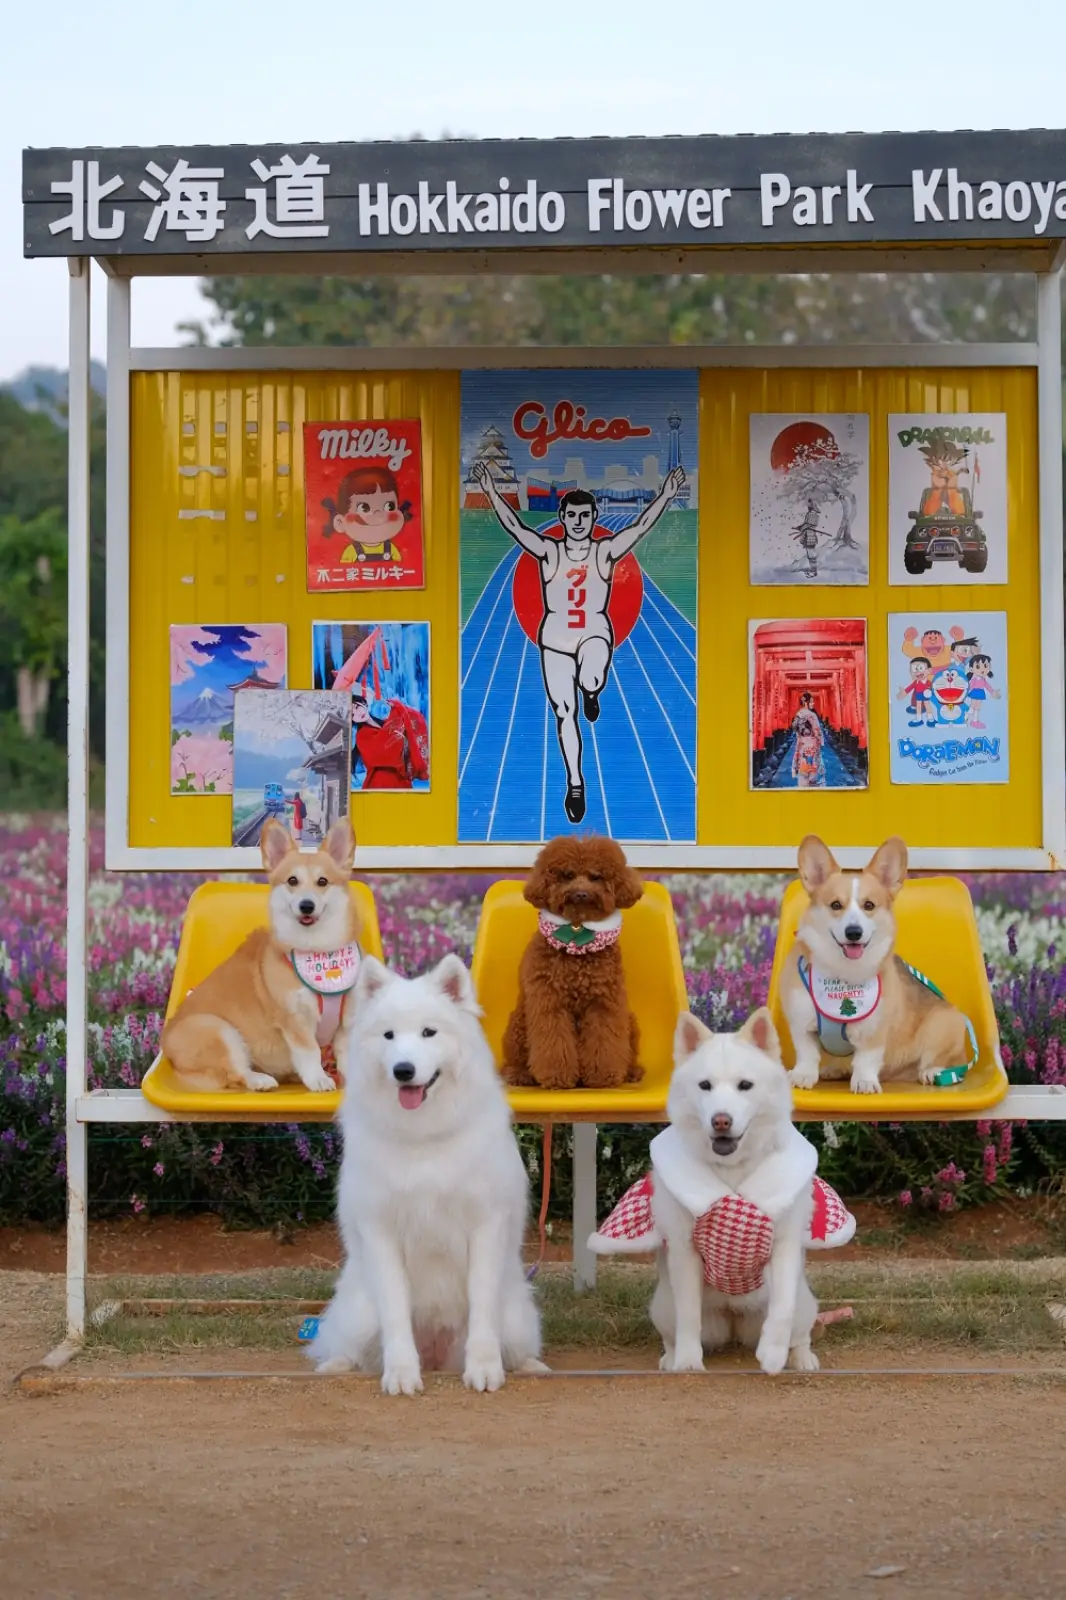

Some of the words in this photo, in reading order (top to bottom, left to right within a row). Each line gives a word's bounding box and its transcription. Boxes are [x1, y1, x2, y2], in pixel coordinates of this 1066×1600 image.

[48, 153, 331, 242] 北海道
[358, 176, 566, 237] Hokkaido
[587, 176, 732, 233] Flower
[760, 169, 876, 227] Park
[317, 428, 413, 472] Milky
[512, 399, 652, 459] Glico
[316, 564, 416, 583] 不二家ミルキー
[566, 564, 589, 629] グリコ
